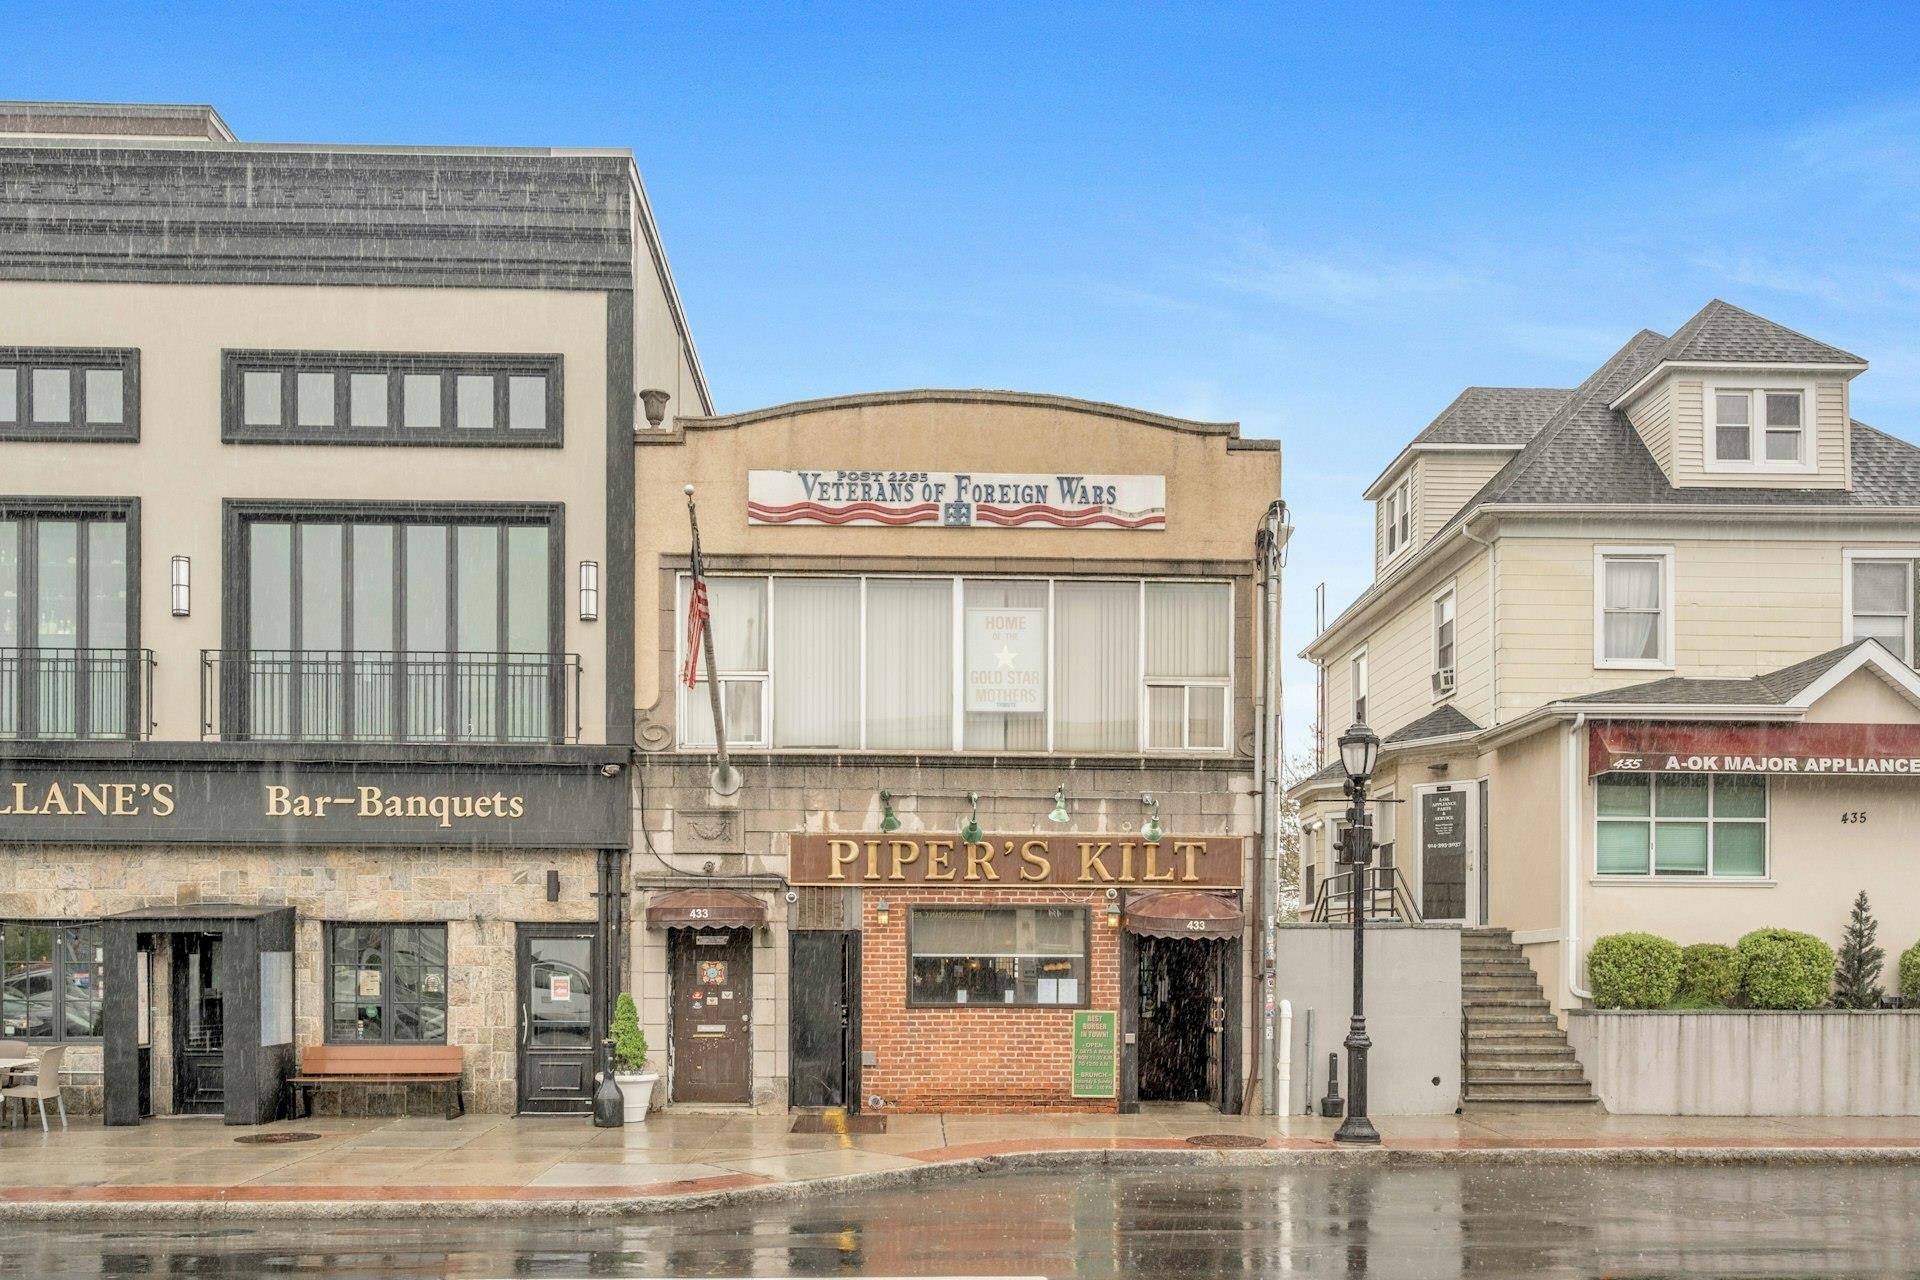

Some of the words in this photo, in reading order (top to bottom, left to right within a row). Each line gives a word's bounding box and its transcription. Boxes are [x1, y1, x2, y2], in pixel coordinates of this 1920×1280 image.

[837, 471, 883, 482] POST
[888, 472, 928, 483] 2285
[798, 473, 914, 502] VETERANS
[922, 483, 946, 502] OF
[954, 475, 1048, 504] FOREIGN
[1057, 476, 1117, 505] WARS
[985, 616, 1026, 630] HOME
[992, 632, 1001, 640] OF
[1006, 632, 1018, 640] THE
[970, 670, 1002, 684] GOLD
[1008, 670, 1040, 684] STAR
[976, 688, 1036, 703] MOTHERS
[1613, 758, 1643, 769] 435
[1664, 756, 1718, 771] A-OK
[1724, 757, 1798, 772] MAJOR
[1804, 757, 1920, 773] APPLIANCE
[1840, 811, 1867, 824] 435
[827, 839, 1051, 883] PIPER'S
[1077, 841, 1207, 883] KILT
[689, 908, 709, 919] 433
[1187, 920, 1206, 931] 433
